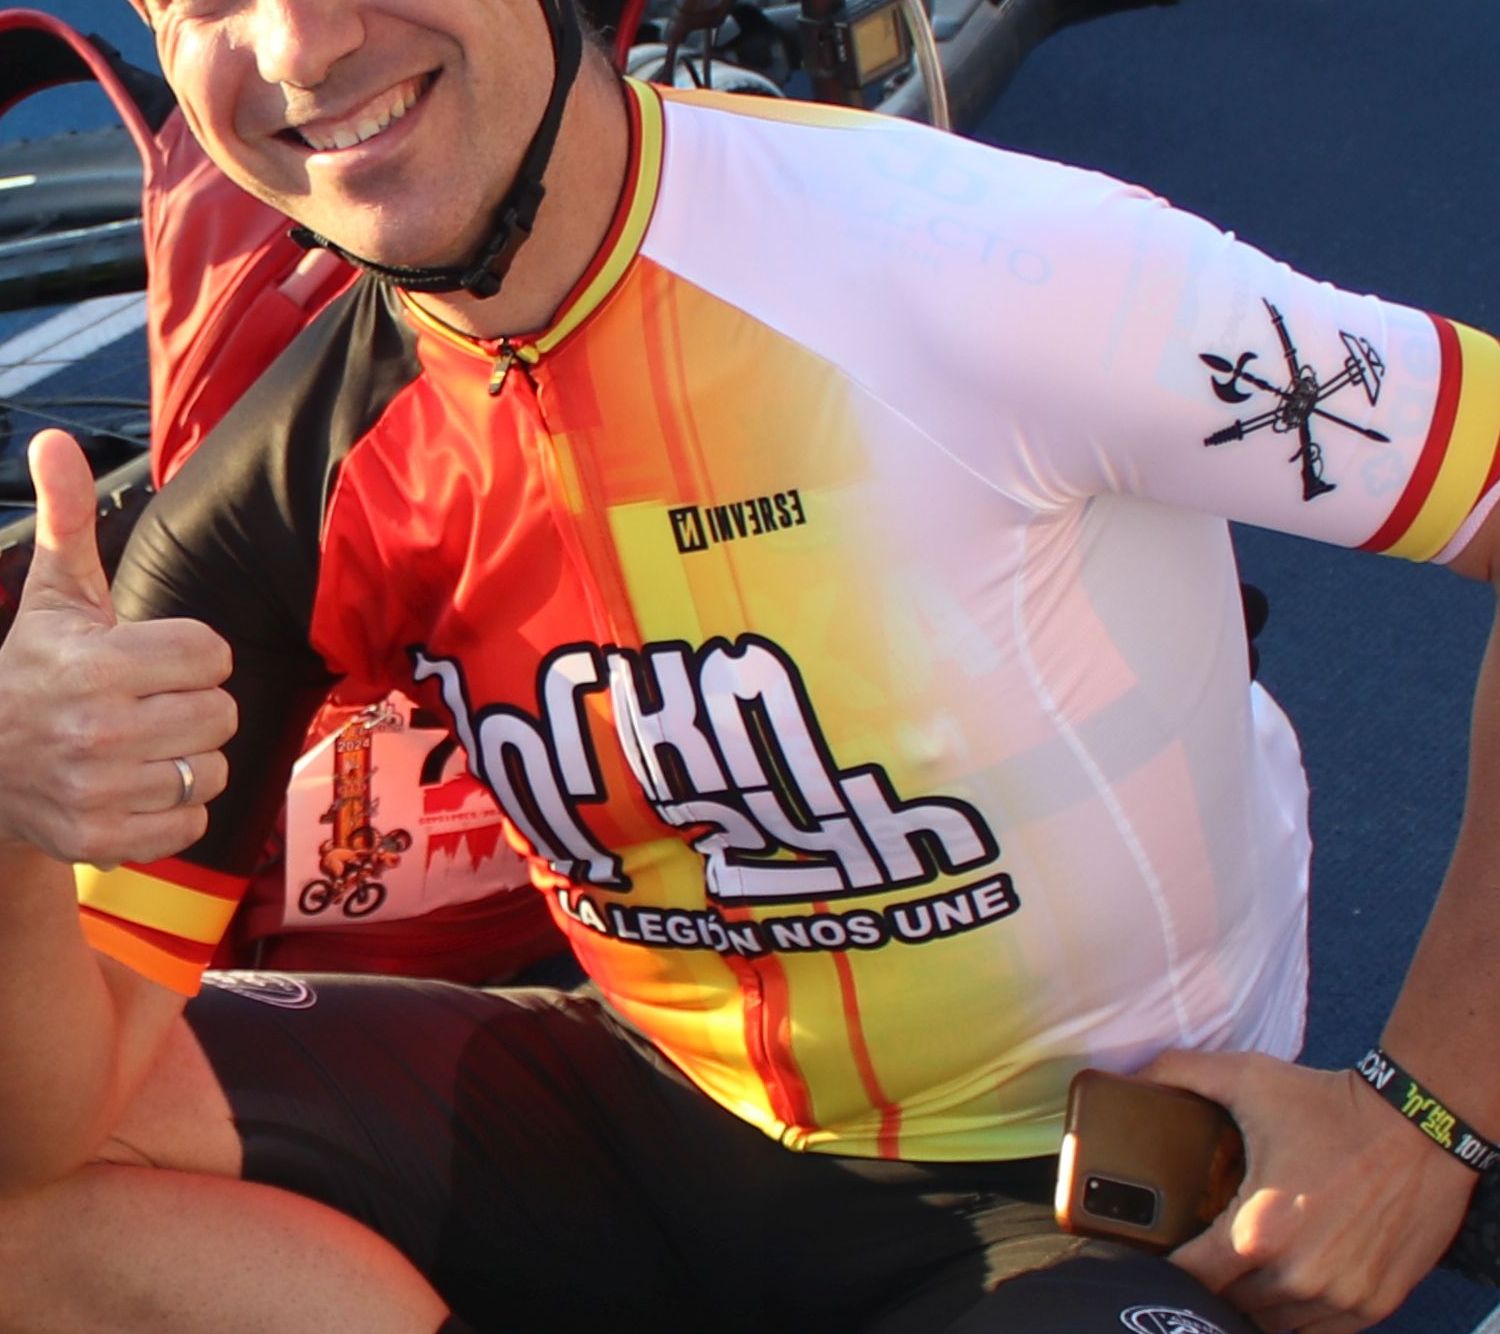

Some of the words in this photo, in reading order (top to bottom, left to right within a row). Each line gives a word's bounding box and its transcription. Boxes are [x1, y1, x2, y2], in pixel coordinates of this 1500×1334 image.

[705, 489, 807, 544] INVERSE
[616, 908, 764, 955] LEGIÓN
[772, 912, 882, 952] NOS
[892, 876, 1012, 941] UNE
[1455, 1133, 1488, 1165] 101
